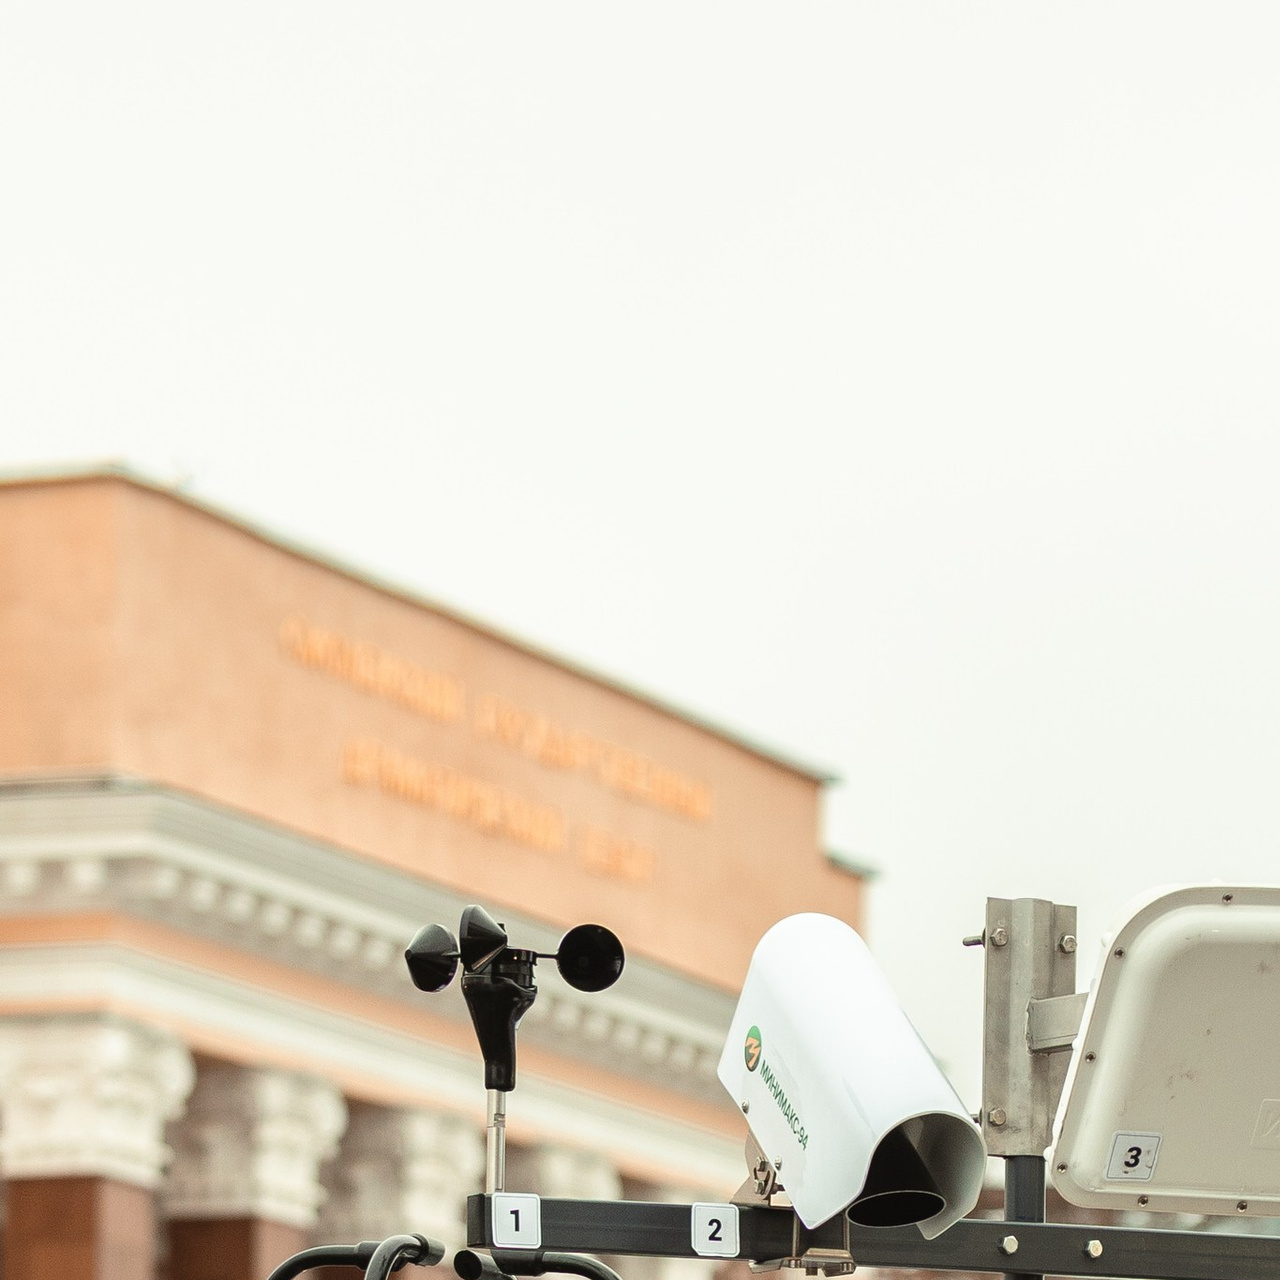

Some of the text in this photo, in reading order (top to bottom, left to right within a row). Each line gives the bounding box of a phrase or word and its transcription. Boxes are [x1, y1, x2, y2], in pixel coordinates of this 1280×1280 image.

[761, 1058, 809, 1152] МИНИМАКС-94
[1123, 1146, 1142, 1168] 3
[509, 1209, 521, 1232] 1
[708, 1218, 723, 1242] 2
